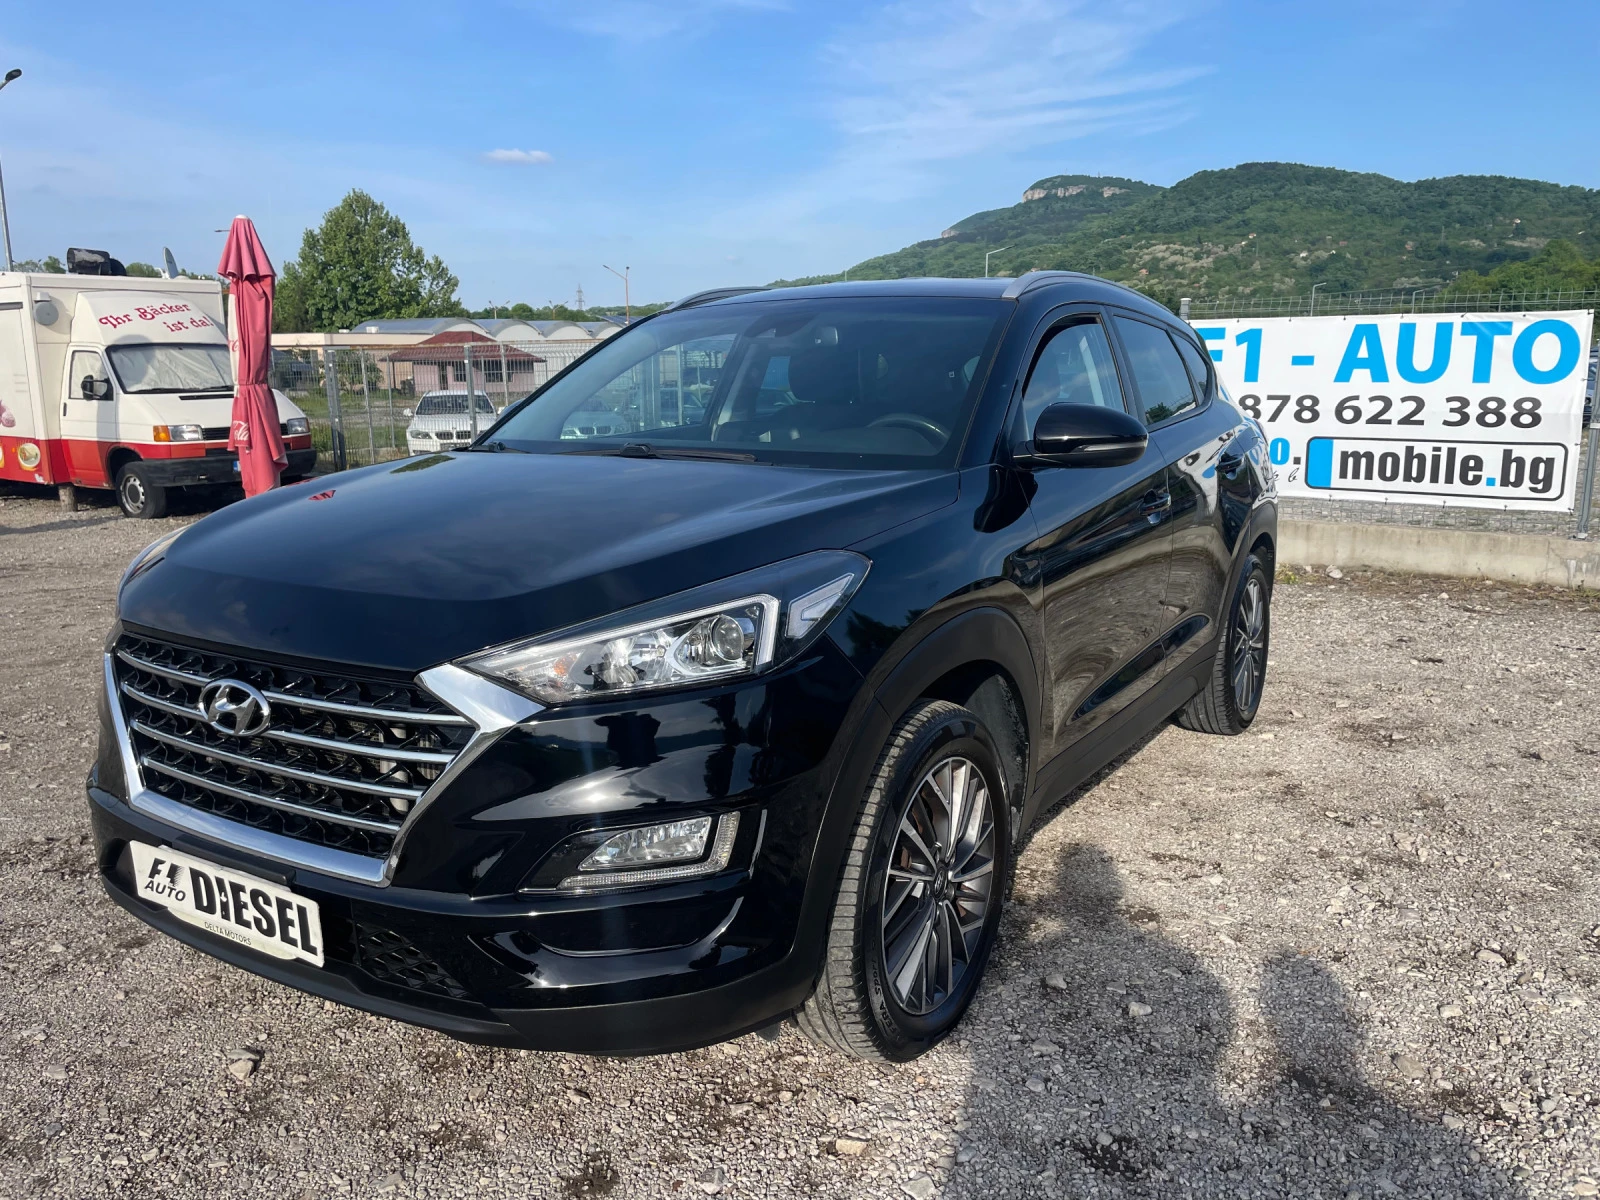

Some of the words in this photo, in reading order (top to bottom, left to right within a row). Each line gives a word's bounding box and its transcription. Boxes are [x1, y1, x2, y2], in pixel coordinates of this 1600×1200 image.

[99, 313, 133, 329] Ihr
[134, 303, 191, 321] Bäcker
[163, 320, 189, 332] ist
[190, 316, 215, 328] da!
[1291, 355, 1315, 366] -
[1334, 319, 1581, 385] AUTO
[1239, 394, 1320, 424] 878
[1335, 395, 1426, 426] 622
[1442, 396, 1542, 428] 388
[1339, 446, 1555, 494] mobile.bg
[144, 880, 186, 901] AUTO
[189, 866, 318, 957] DIESEL
[204, 921, 225, 935] DELTA
[225, 929, 252, 946] MOTORS
